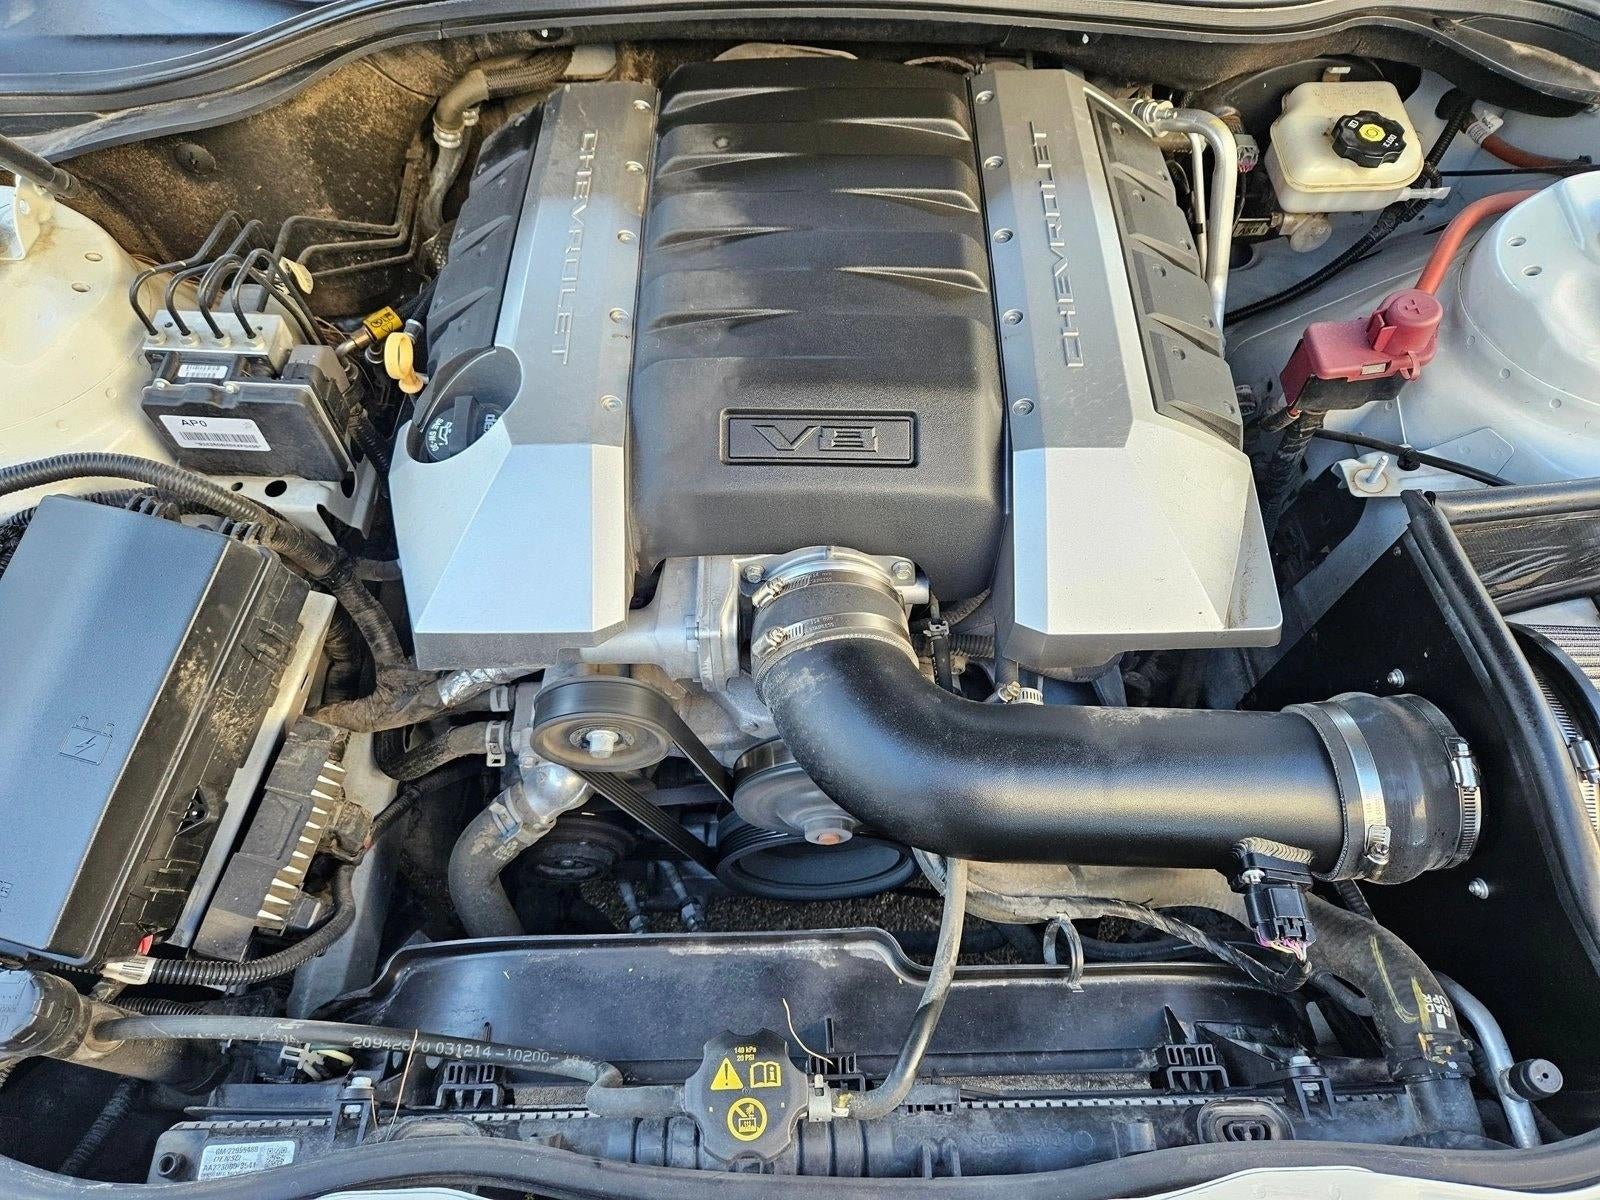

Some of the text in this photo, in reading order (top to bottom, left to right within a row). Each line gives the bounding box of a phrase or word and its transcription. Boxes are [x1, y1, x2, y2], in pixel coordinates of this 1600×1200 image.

[552, 129, 599, 365] CHEVROLET
[1030, 121, 1084, 367] CHEVROLET
[751, 425, 879, 452] V8
